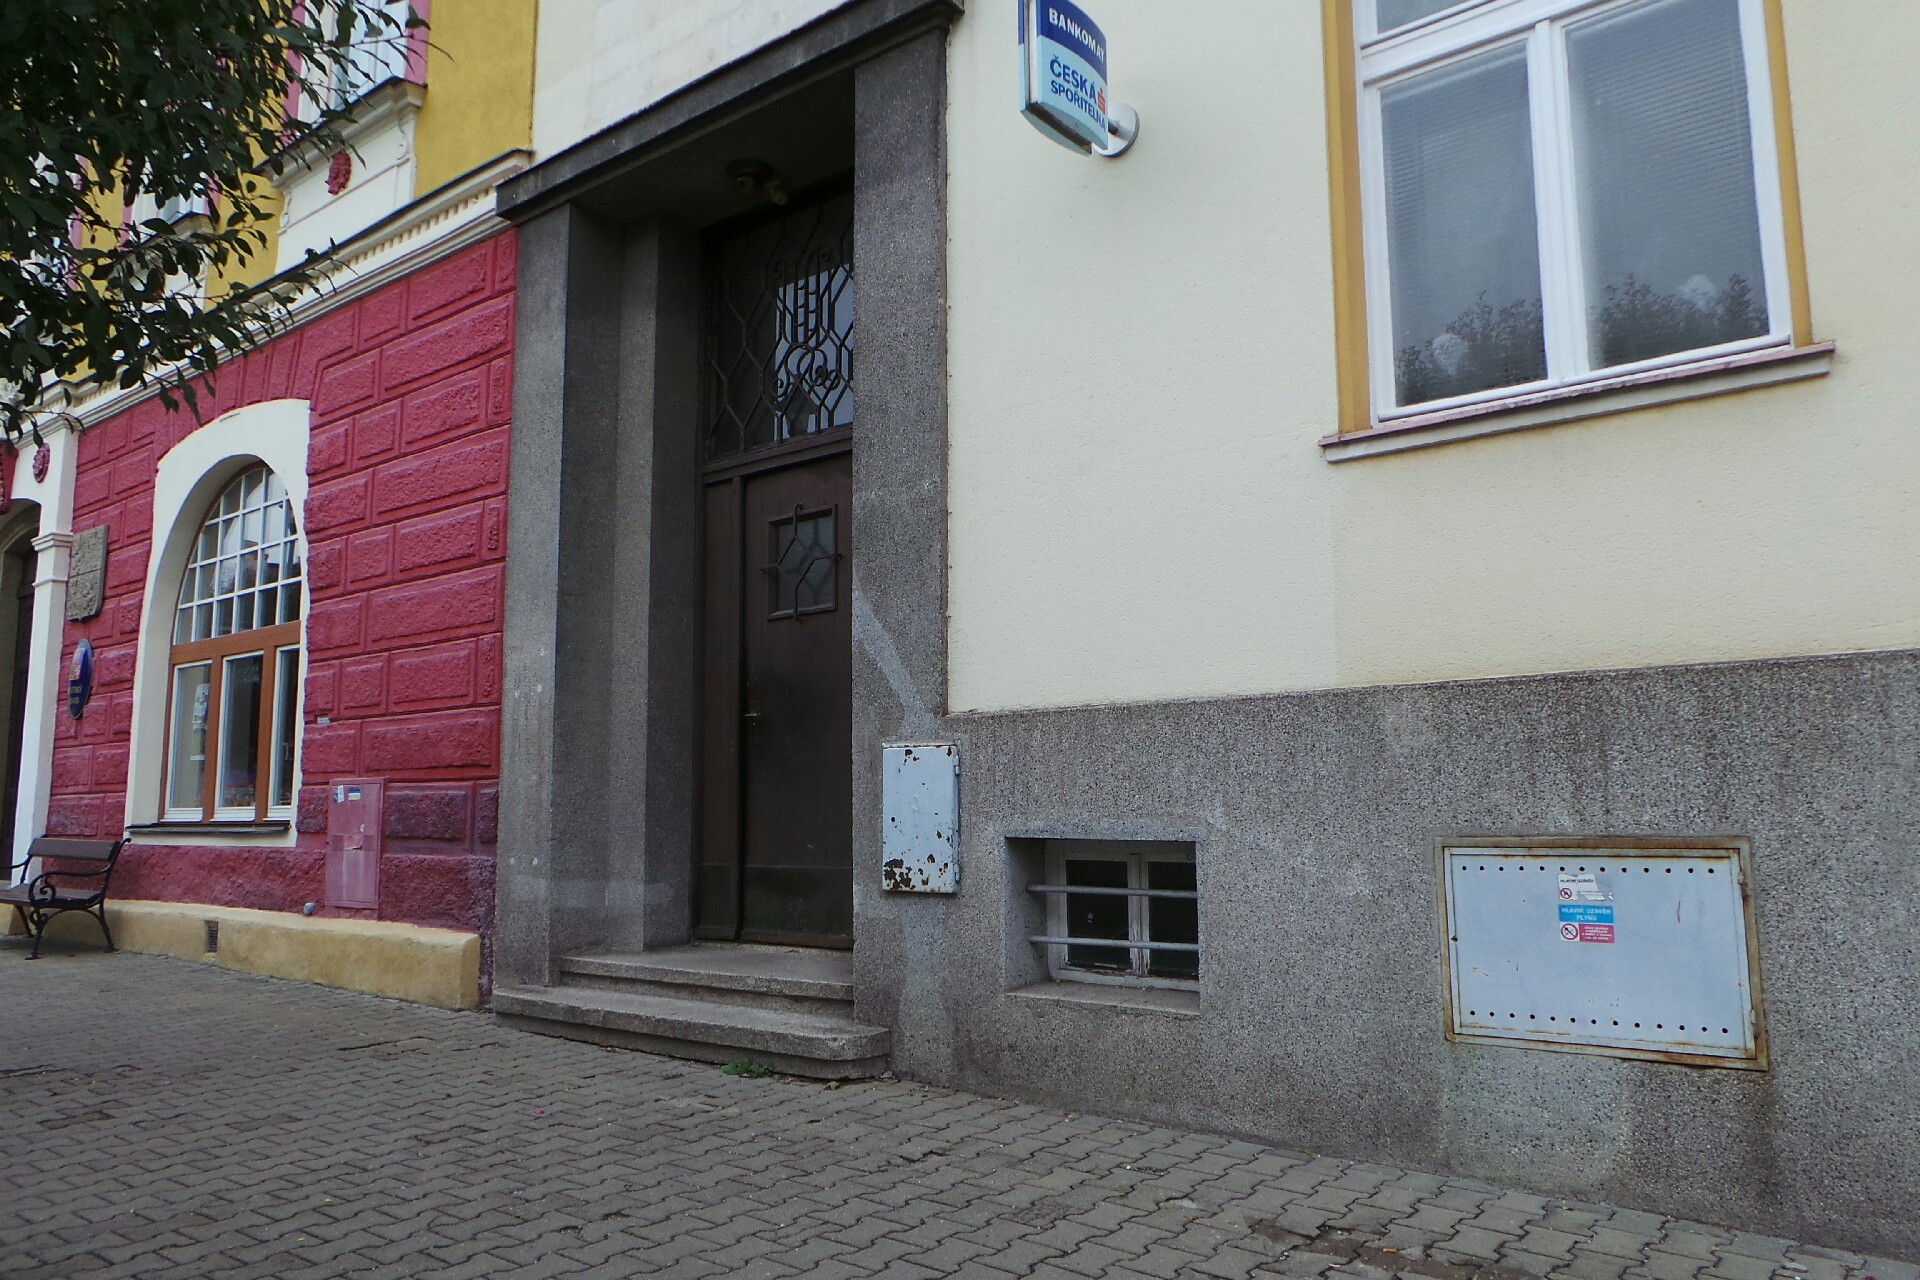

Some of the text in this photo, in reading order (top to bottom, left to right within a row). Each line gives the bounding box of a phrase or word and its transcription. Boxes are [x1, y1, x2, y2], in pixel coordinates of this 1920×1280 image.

[1048, 7, 1105, 63] BANKOMAT
[1049, 54, 1097, 105] ČESKÁ
[1051, 79, 1106, 131] SPOŘITELNA
